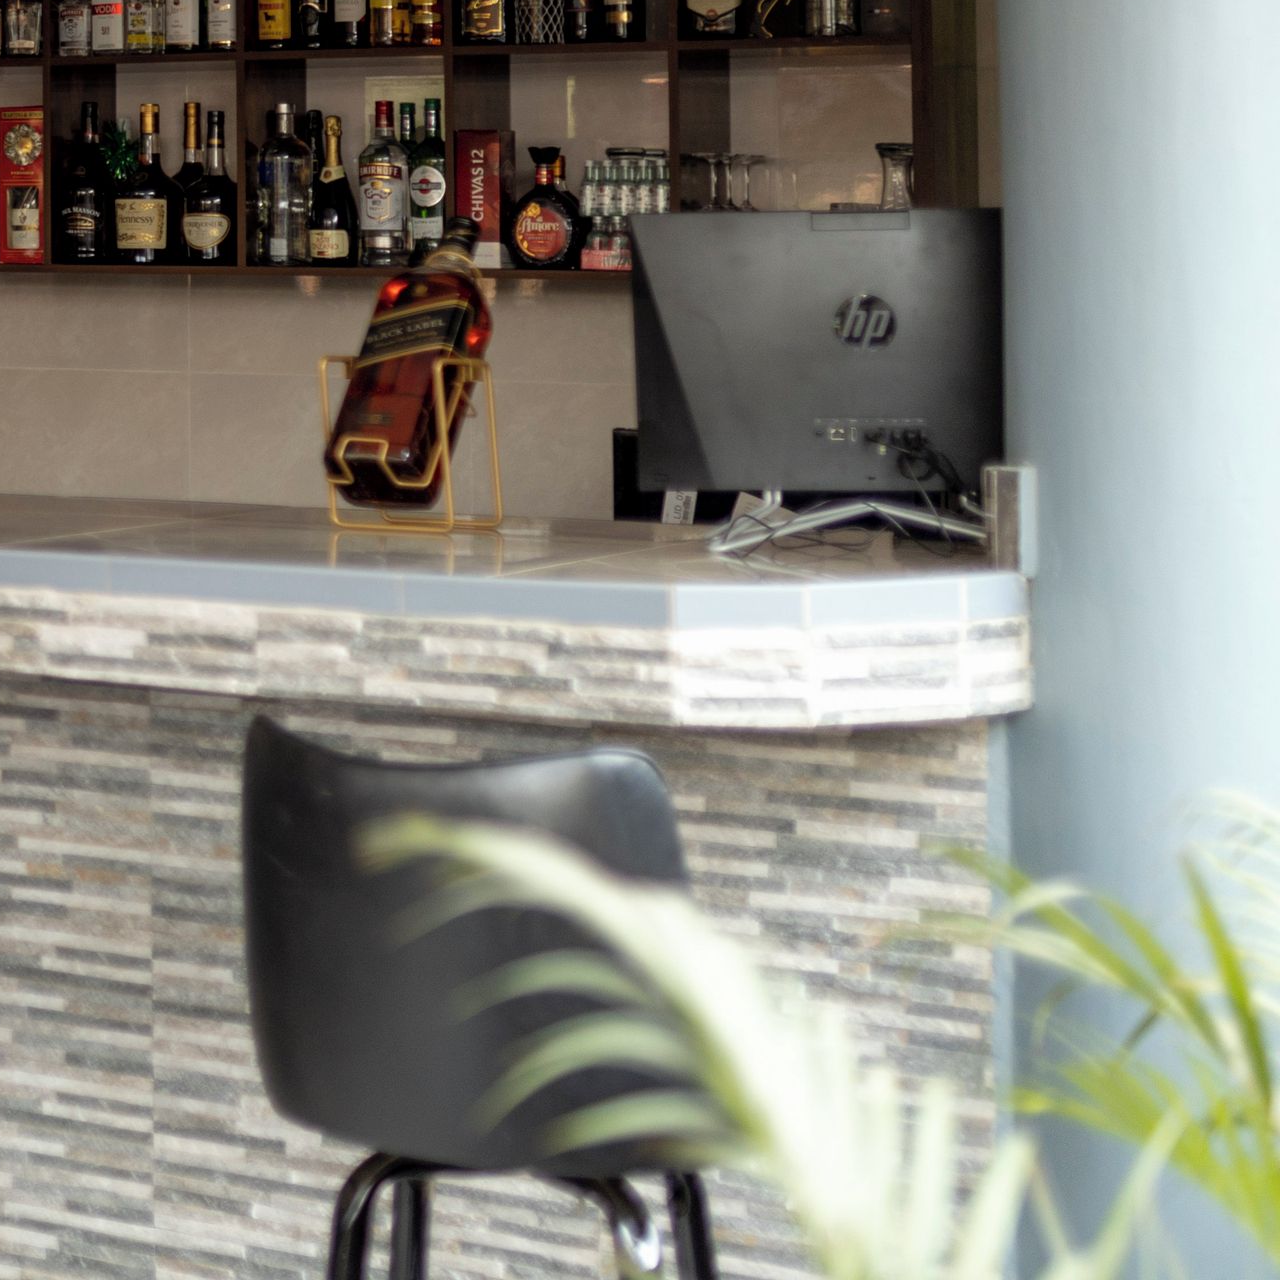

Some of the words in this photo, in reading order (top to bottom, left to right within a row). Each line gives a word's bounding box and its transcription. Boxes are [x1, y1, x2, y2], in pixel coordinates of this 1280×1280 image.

[470, 148, 485, 165] 12
[470, 168, 485, 222] CHIVAS
[520, 218, 560, 233] Amore
[366, 328, 403, 344] BLACK
[406, 318, 446, 334] LABEL
[842, 296, 891, 349] hp
